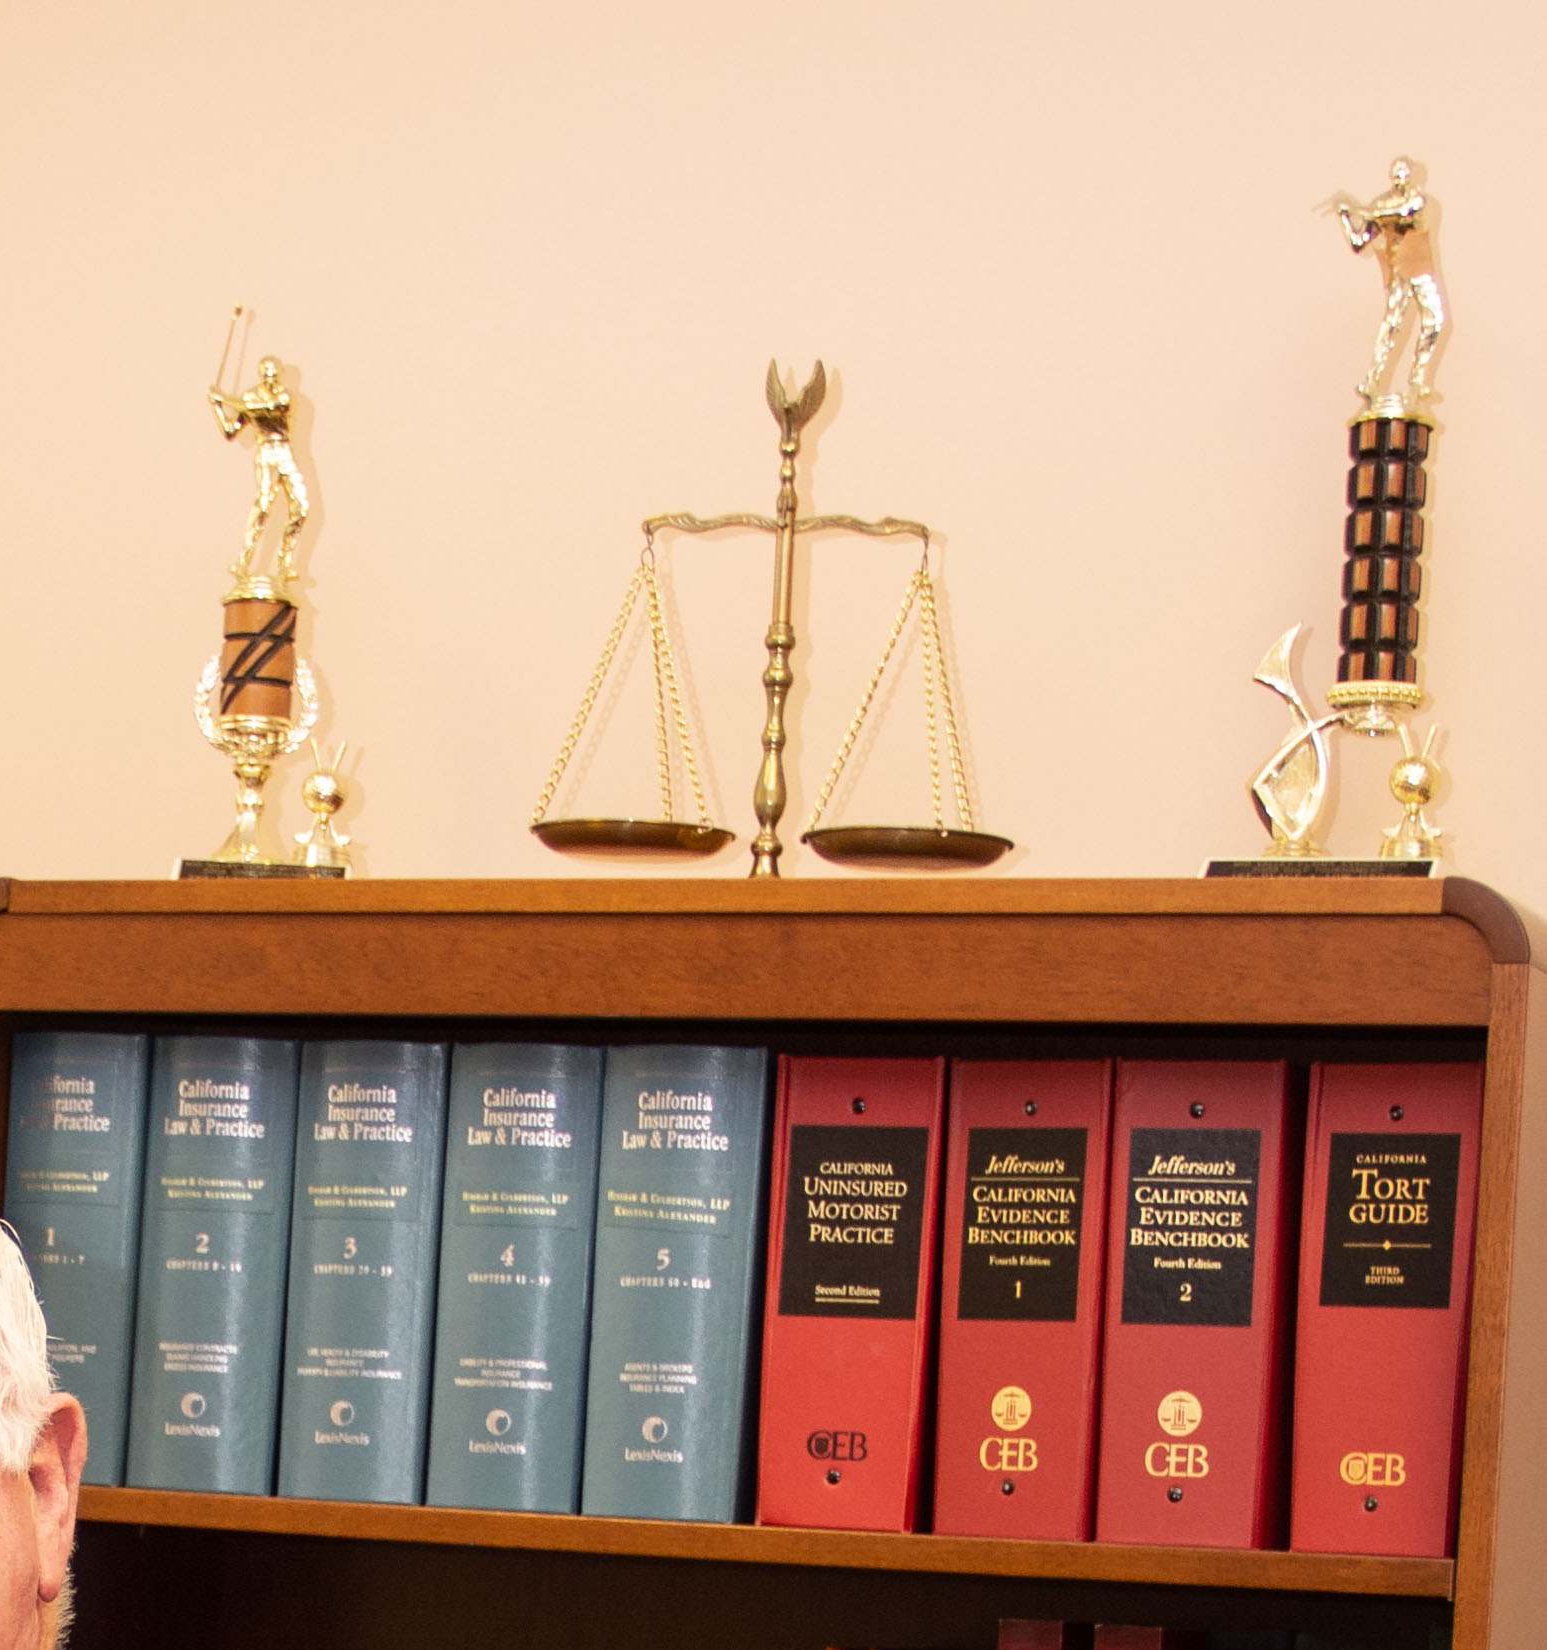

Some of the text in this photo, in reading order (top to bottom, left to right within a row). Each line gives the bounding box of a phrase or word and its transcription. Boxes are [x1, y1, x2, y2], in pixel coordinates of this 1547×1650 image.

[178, 1079, 250, 1100] California
[327, 1083, 397, 1104] California
[483, 1087, 557, 1108] California
[178, 1100, 248, 1118] Insurance
[638, 1090, 713, 1111] California
[327, 1105, 396, 1123] Insurance
[483, 1108, 554, 1128] Insurance
[638, 1111, 711, 1130] Insurance
[164, 1117, 265, 1138] Law & Practice
[314, 1123, 413, 1143] Law & Practice
[467, 1127, 572, 1148] Law & Practice
[622, 1130, 729, 1151] Law & Practice
[820, 1162, 894, 1176] CALIFORNIA
[985, 1155, 1065, 1175] Jefferson's
[1148, 1155, 1236, 1176] Jefferson's
[1356, 1154, 1427, 1164] CALIFORNIA
[804, 1177, 908, 1198] UNINSURED
[1352, 1168, 1430, 1200] TORT
[972, 1186, 1076, 1203] CALIFORNIA
[1134, 1186, 1248, 1205] CALIFORNIA
[657, 1207, 717, 1224] ALEXANDER
[807, 1200, 901, 1221] MOTORIST
[977, 1206, 1070, 1225] EVIDENCE
[1139, 1207, 1242, 1227] EVIDENCE
[1349, 1204, 1429, 1225] GUIDE
[46, 1227, 54, 1247] 1
[196, 1233, 210, 1254] 2
[809, 1224, 894, 1245] PRACTICE
[967, 1227, 1076, 1246] BENCHBOOK
[1129, 1229, 1250, 1248] BENCHBOOK
[343, 1237, 357, 1259] 3
[500, 1244, 515, 1267] 4
[657, 1248, 671, 1271] 5
[989, 1254, 1051, 1267] Fourth Edition
[1153, 1257, 1221, 1270] Fourth Edition
[1365, 1275, 1404, 1285] EDITION
[1370, 1266, 1400, 1275] THIRD
[815, 1284, 881, 1298] Second Edition
[1014, 1281, 1021, 1299] 1
[1179, 1283, 1192, 1302] 2
[164, 1422, 220, 1438] LexisNexis
[315, 1430, 370, 1446] LexisNexis
[469, 1439, 527, 1455] LexisNexis
[624, 1447, 683, 1463] LexisNexis
[806, 1430, 868, 1461] CEB
[979, 1437, 1038, 1472] CEB
[1144, 1442, 1209, 1478] CEB
[1339, 1452, 1406, 1486] CEB
